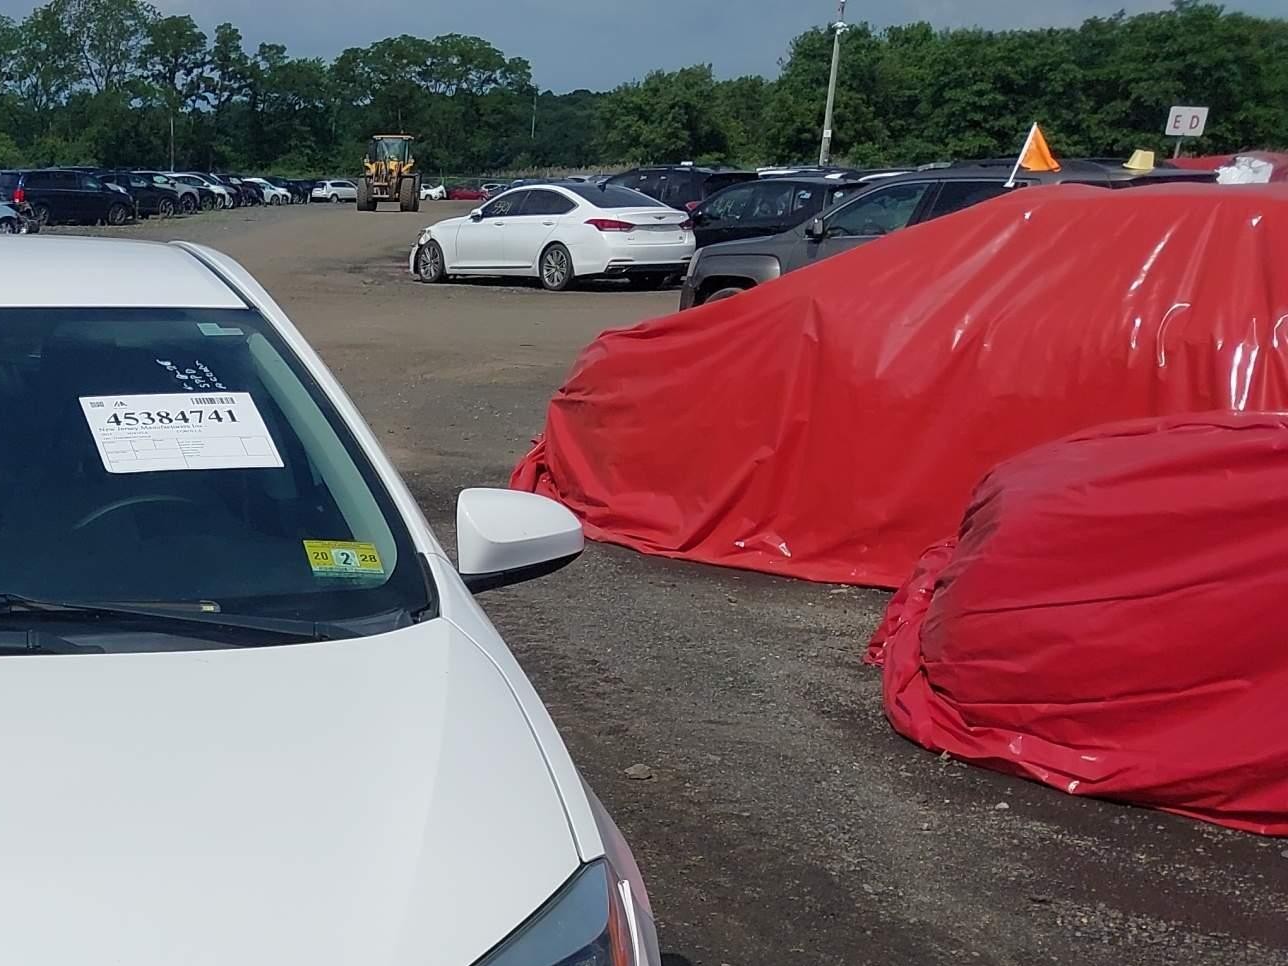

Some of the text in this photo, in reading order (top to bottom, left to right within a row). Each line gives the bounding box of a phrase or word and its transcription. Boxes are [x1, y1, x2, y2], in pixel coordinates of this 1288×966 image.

[1173, 114, 1200, 130] E D
[107, 409, 240, 426] 45384741
[117, 425, 139, 433] Jersey
[140, 423, 191, 431] Manufacturers
[312, 551, 378, 566] 20 2 28
